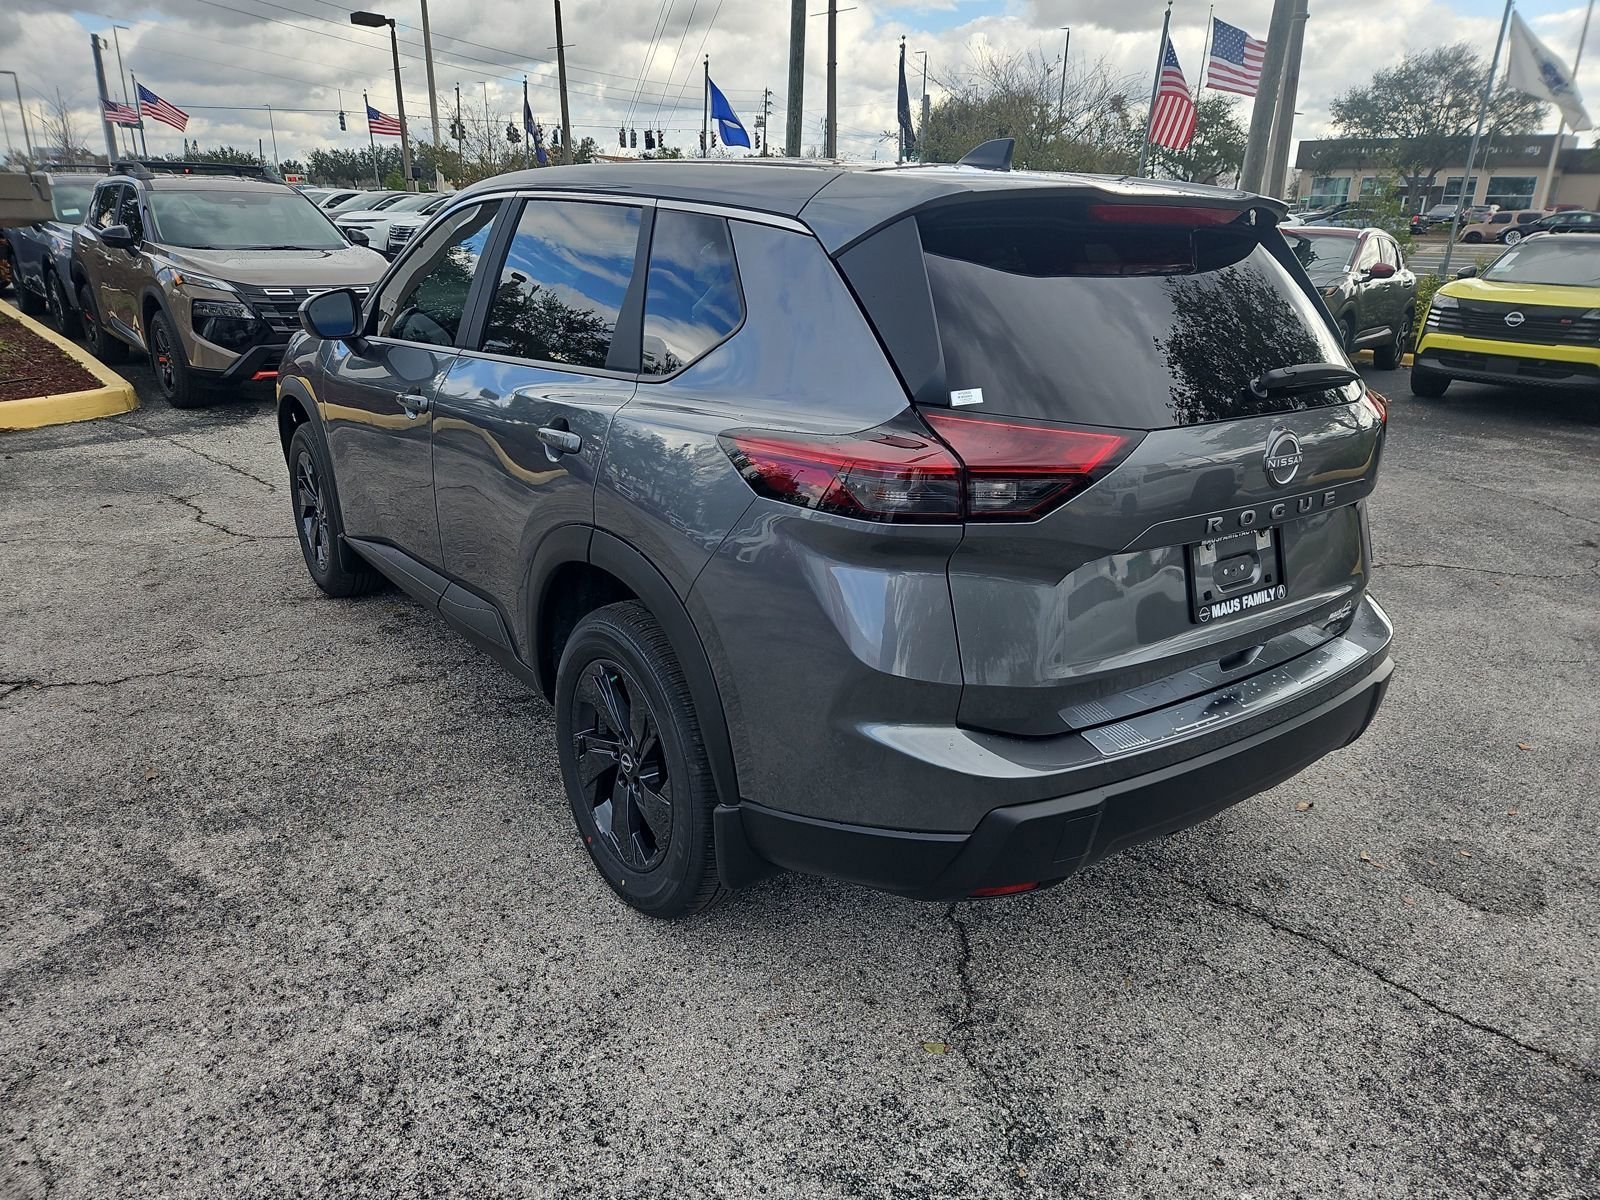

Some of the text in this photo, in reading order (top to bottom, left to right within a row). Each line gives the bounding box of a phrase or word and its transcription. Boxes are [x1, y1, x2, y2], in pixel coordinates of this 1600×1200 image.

[1268, 455, 1303, 468] NISSAN
[1206, 491, 1336, 533] ROGUE
[1211, 588, 1276, 619] MAUS FAMILY
